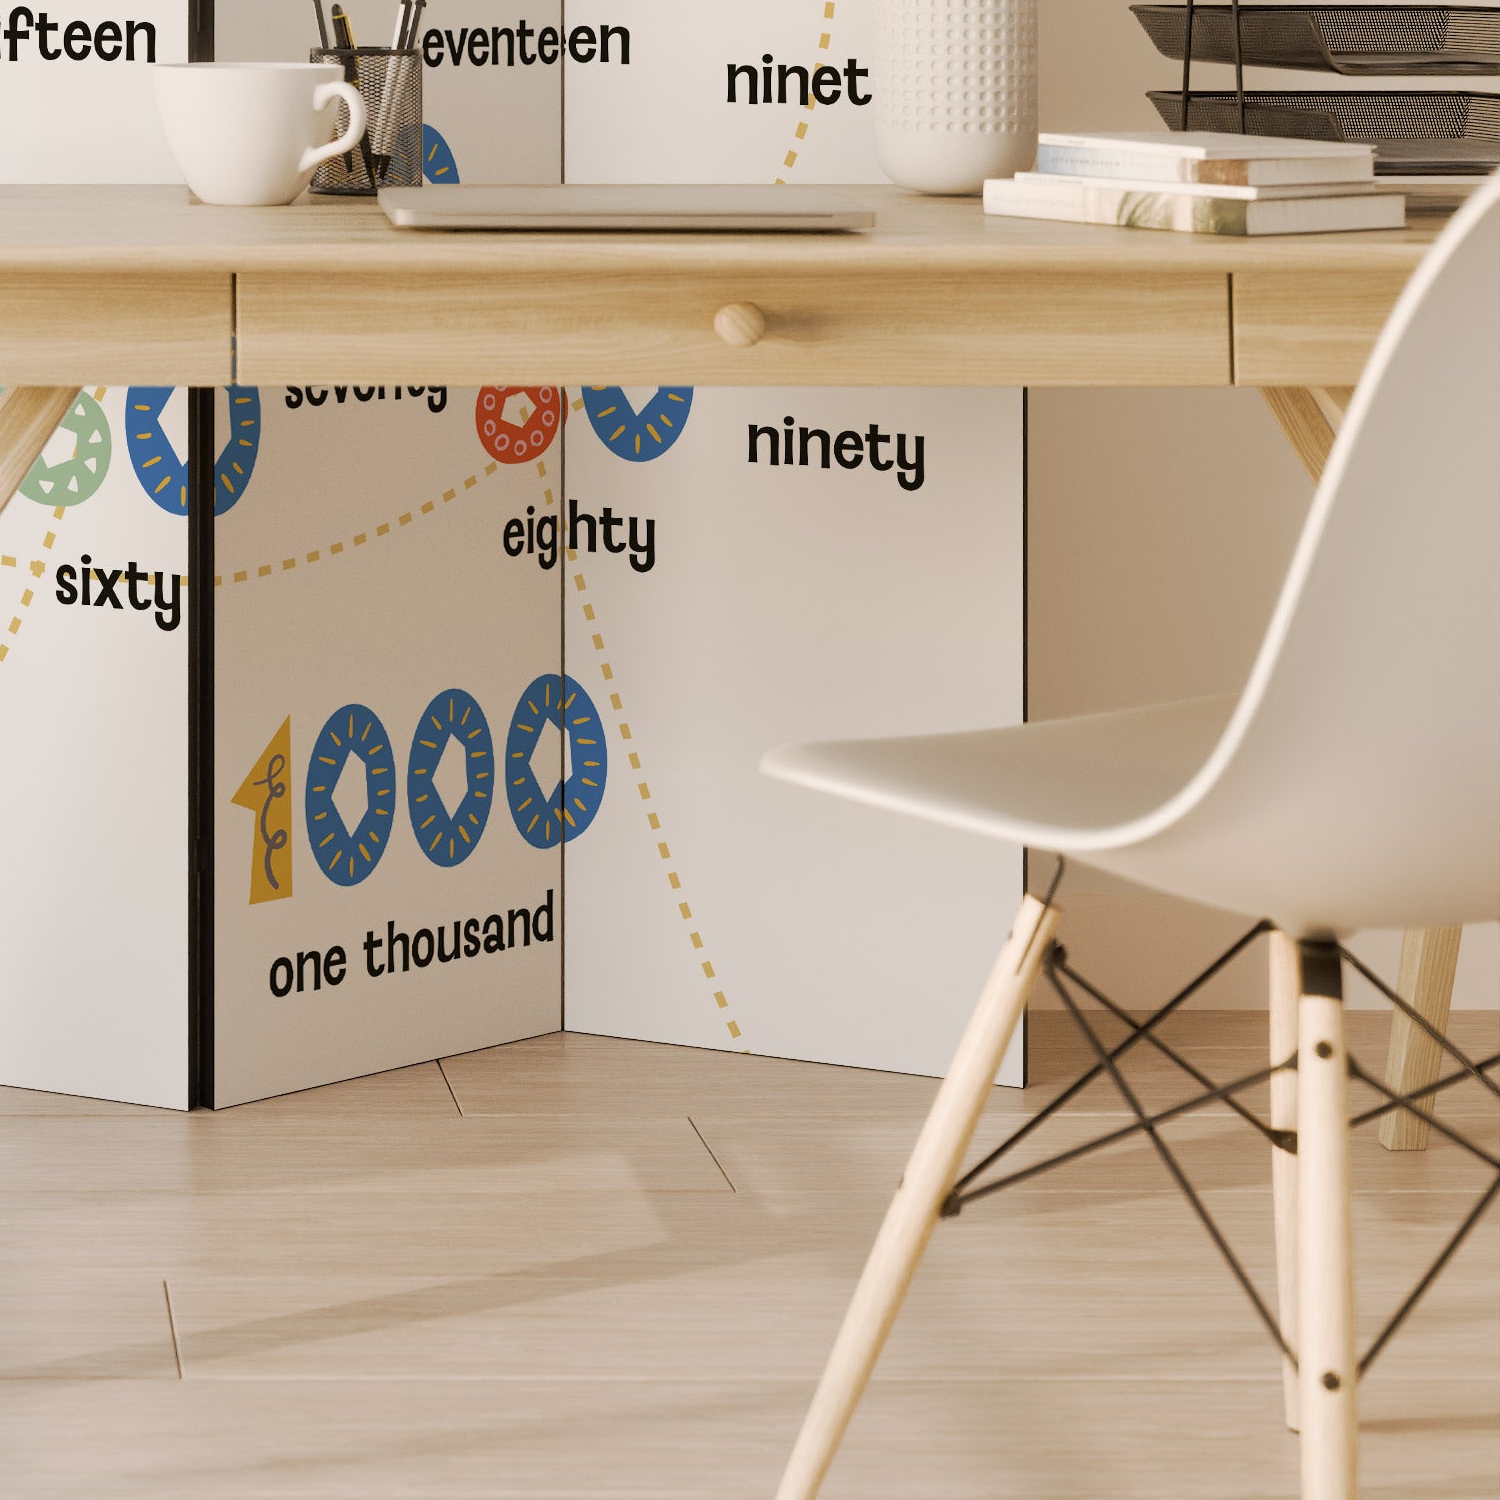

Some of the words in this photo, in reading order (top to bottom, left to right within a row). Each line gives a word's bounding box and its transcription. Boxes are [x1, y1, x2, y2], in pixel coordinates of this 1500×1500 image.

[418, 19, 630, 67] eventeen
[727, 54, 873, 106] ninet
[748, 416, 925, 491] ninety
[504, 500, 656, 573] eighty
[56, 555, 181, 631] sixty
[232, 674, 607, 904] 1000
[269, 945, 347, 998] one
[362, 889, 554, 978] thousand
